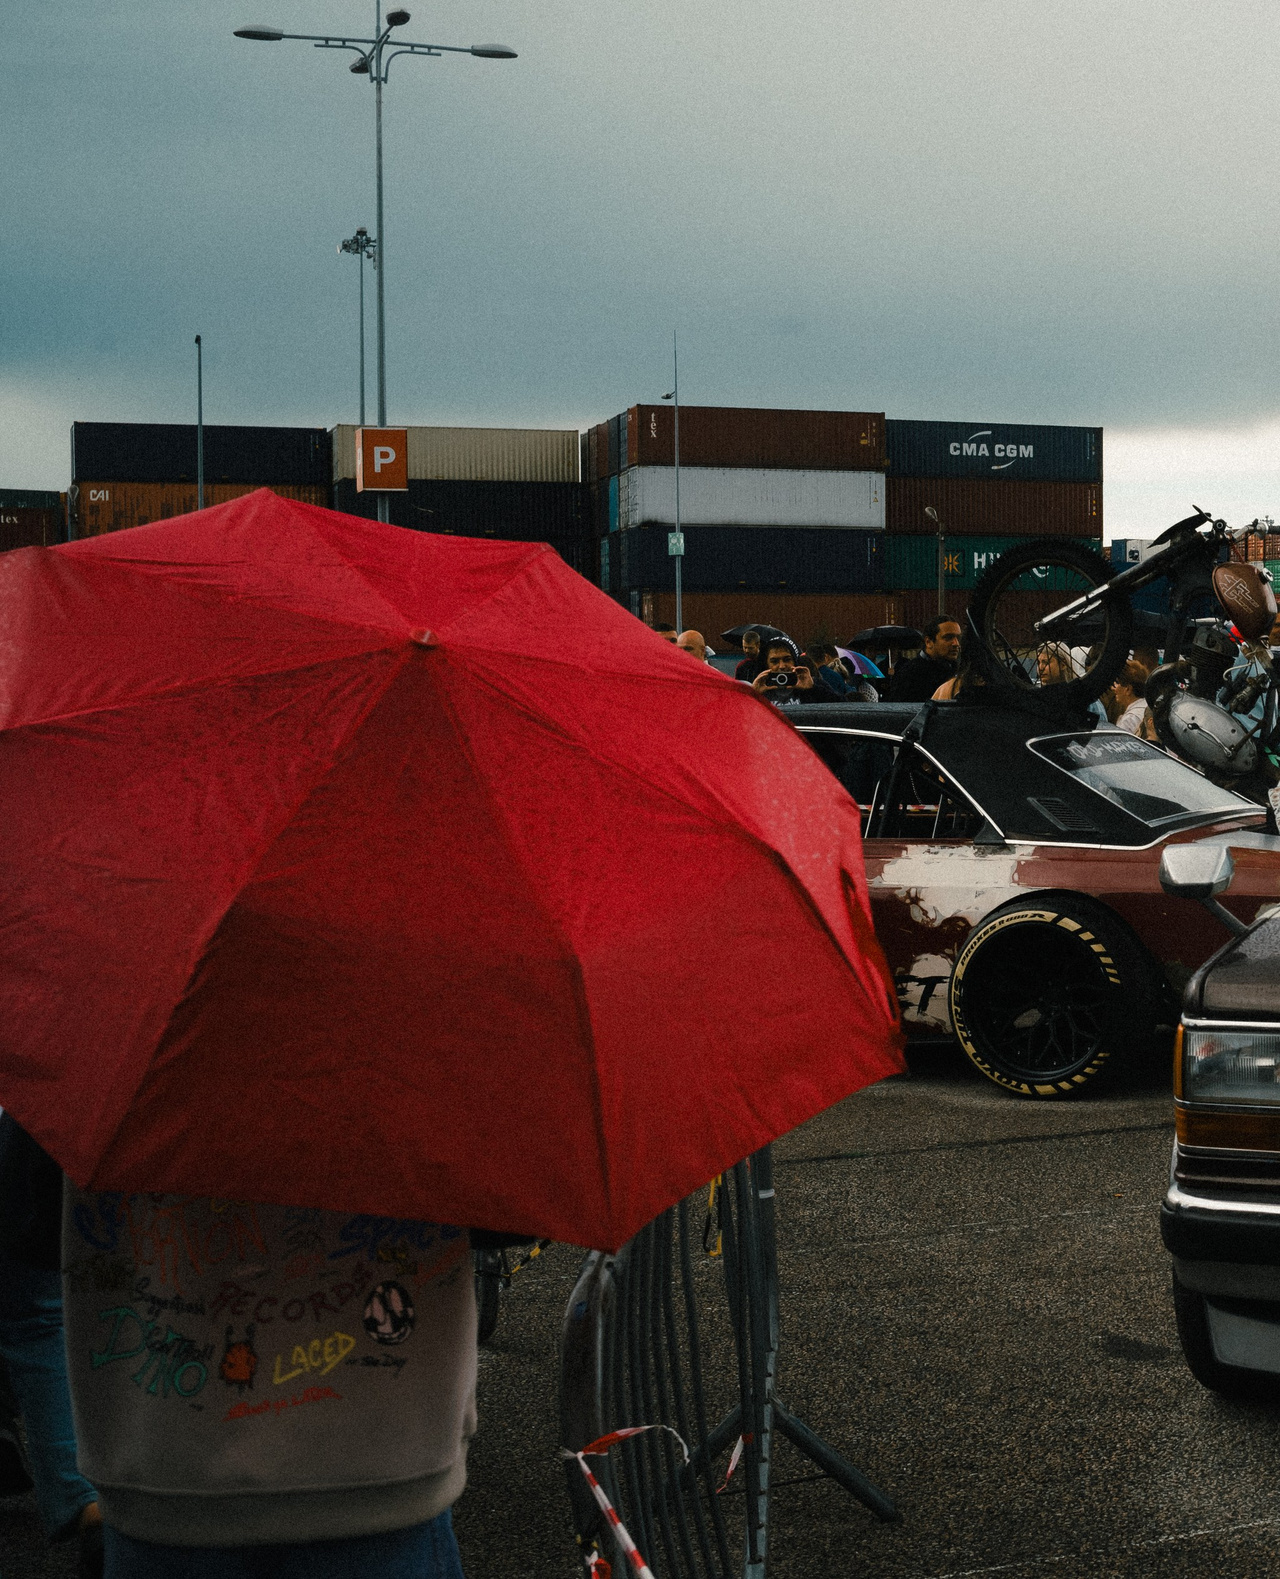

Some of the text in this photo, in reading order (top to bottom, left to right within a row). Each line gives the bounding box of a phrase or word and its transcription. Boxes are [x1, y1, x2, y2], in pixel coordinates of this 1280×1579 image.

[374, 446, 396, 473] P
[949, 442, 1034, 458] CMA CGM
[89, 489, 109, 501] CAI
[959, 923, 998, 967] PROXES
[273, 1331, 357, 1385] LACED
